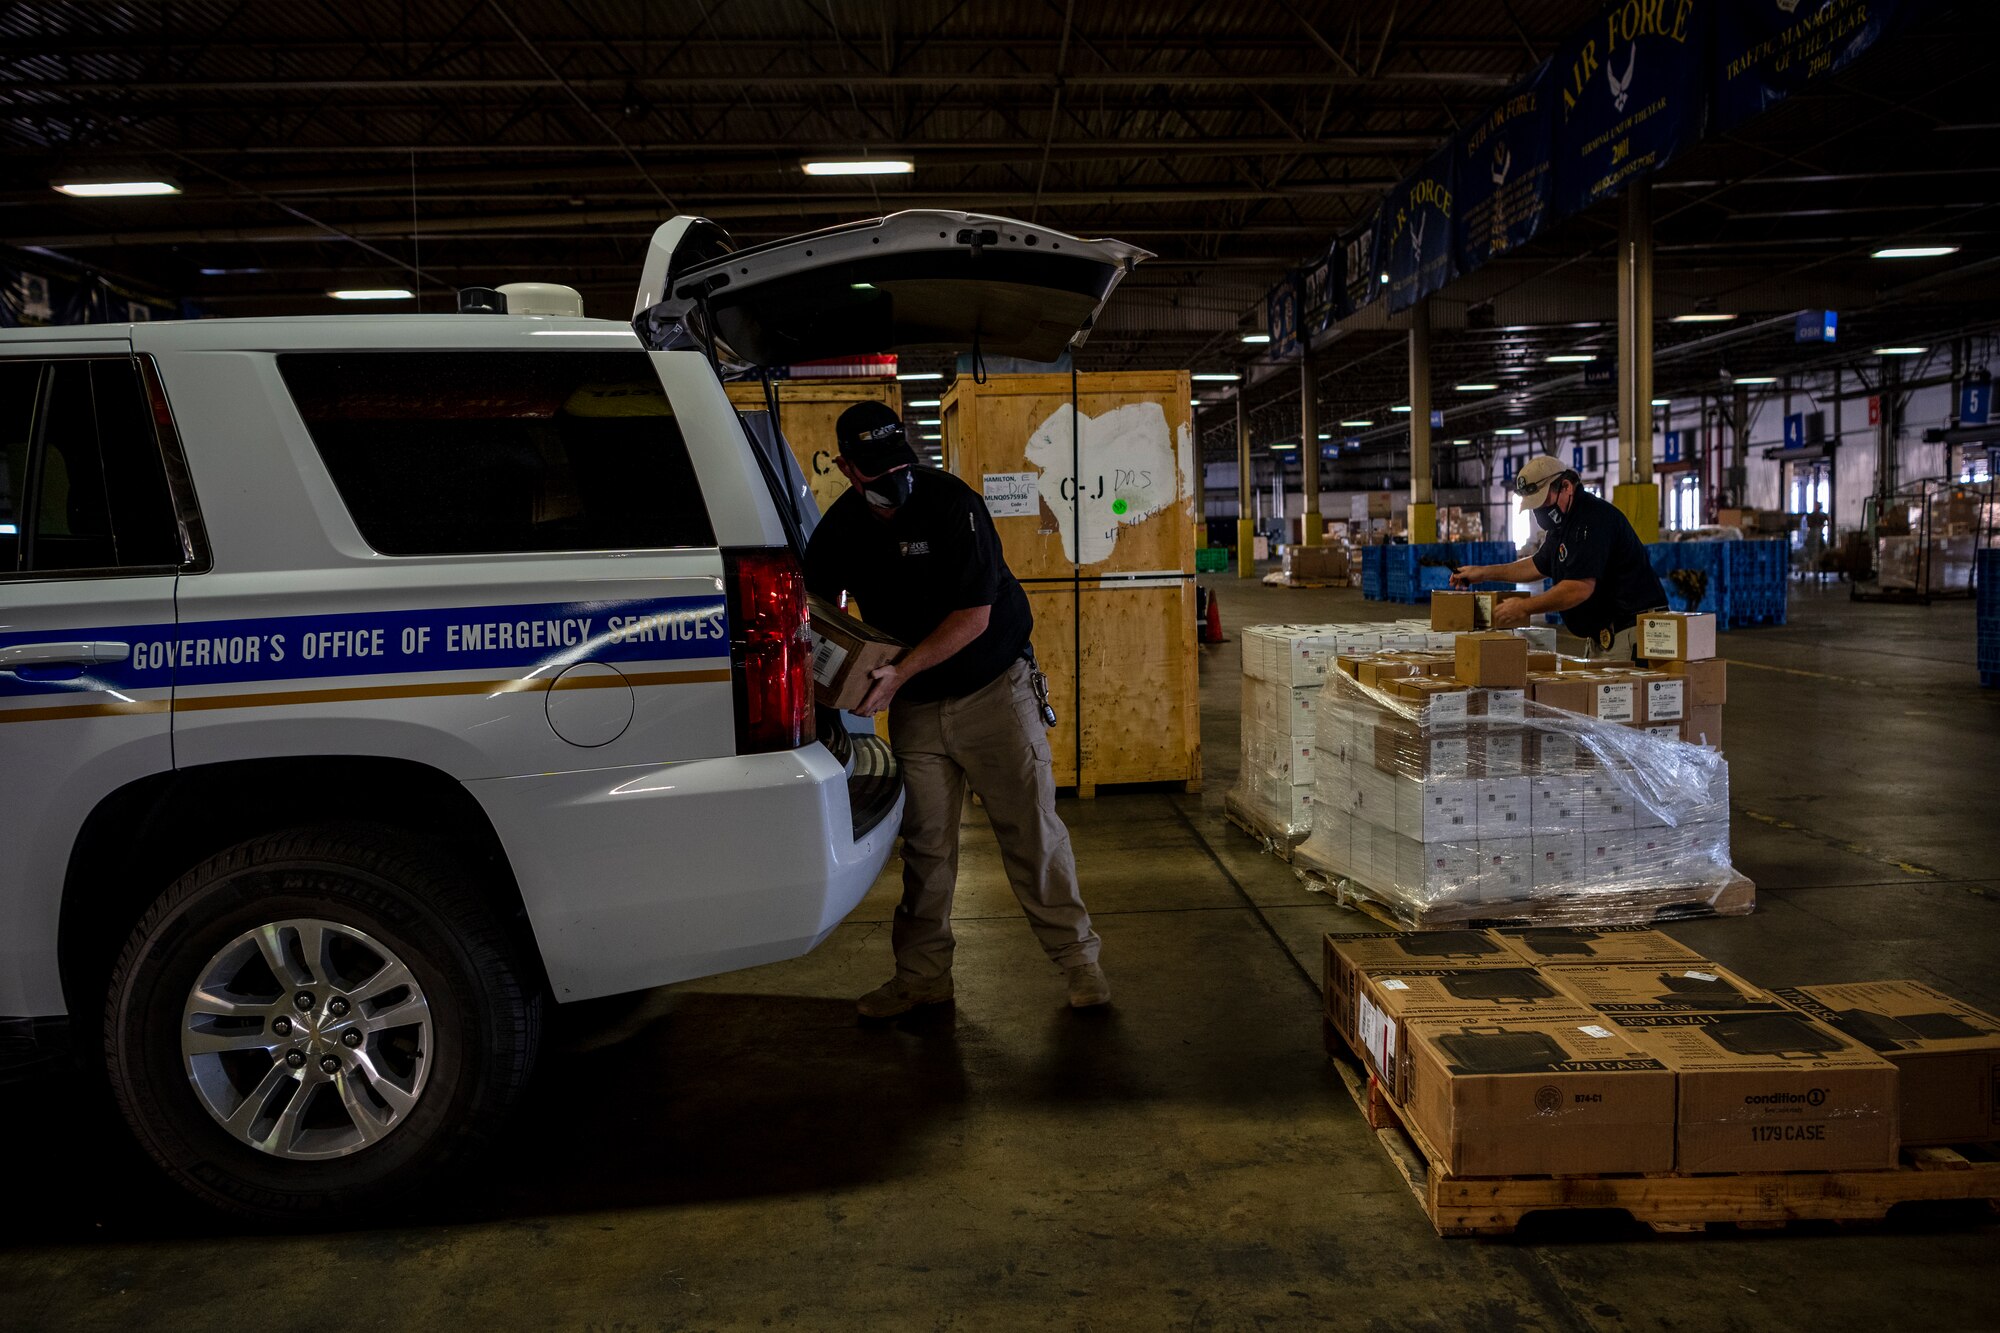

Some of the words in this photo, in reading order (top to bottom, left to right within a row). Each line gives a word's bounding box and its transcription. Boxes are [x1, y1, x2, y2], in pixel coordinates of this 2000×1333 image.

[1775, 50, 1792, 72] OF
[1797, 31, 1824, 61] THE
[1828, 4, 1867, 42] YEAR
[1563, 39, 1599, 124] AIR
[1607, 0, 1694, 55] FORCE
[1726, 37, 1776, 81] TRAFFIC
[1808, 49, 1832, 79] 2001
[1506, 92, 1537, 120] FORCE
[1410, 178, 1453, 219] FORCE
[1970, 389, 1979, 414] 5
[1790, 422, 1797, 442] 4
[132, 633, 286, 671] GOVERNOR'S
[301, 628, 385, 660] OFFICE
[401, 626, 431, 655] OF
[446, 617, 593, 652] EMERGENCY
[607, 611, 725, 645] SERVICES
[1598, 1003, 1646, 1012] 1179
[1648, 1003, 1698, 1012] CASE
[1775, 988, 1804, 1005] 1179
[1802, 1003, 1844, 1023] CASE
[1621, 1016, 1672, 1026] CASE
[1672, 1015, 1720, 1025] 1179
[1547, 1061, 1598, 1071] 1179
[1600, 1059, 1660, 1071] CASE
[1751, 1125, 1782, 1141] 1179
[1785, 1125, 1825, 1141] CASE
